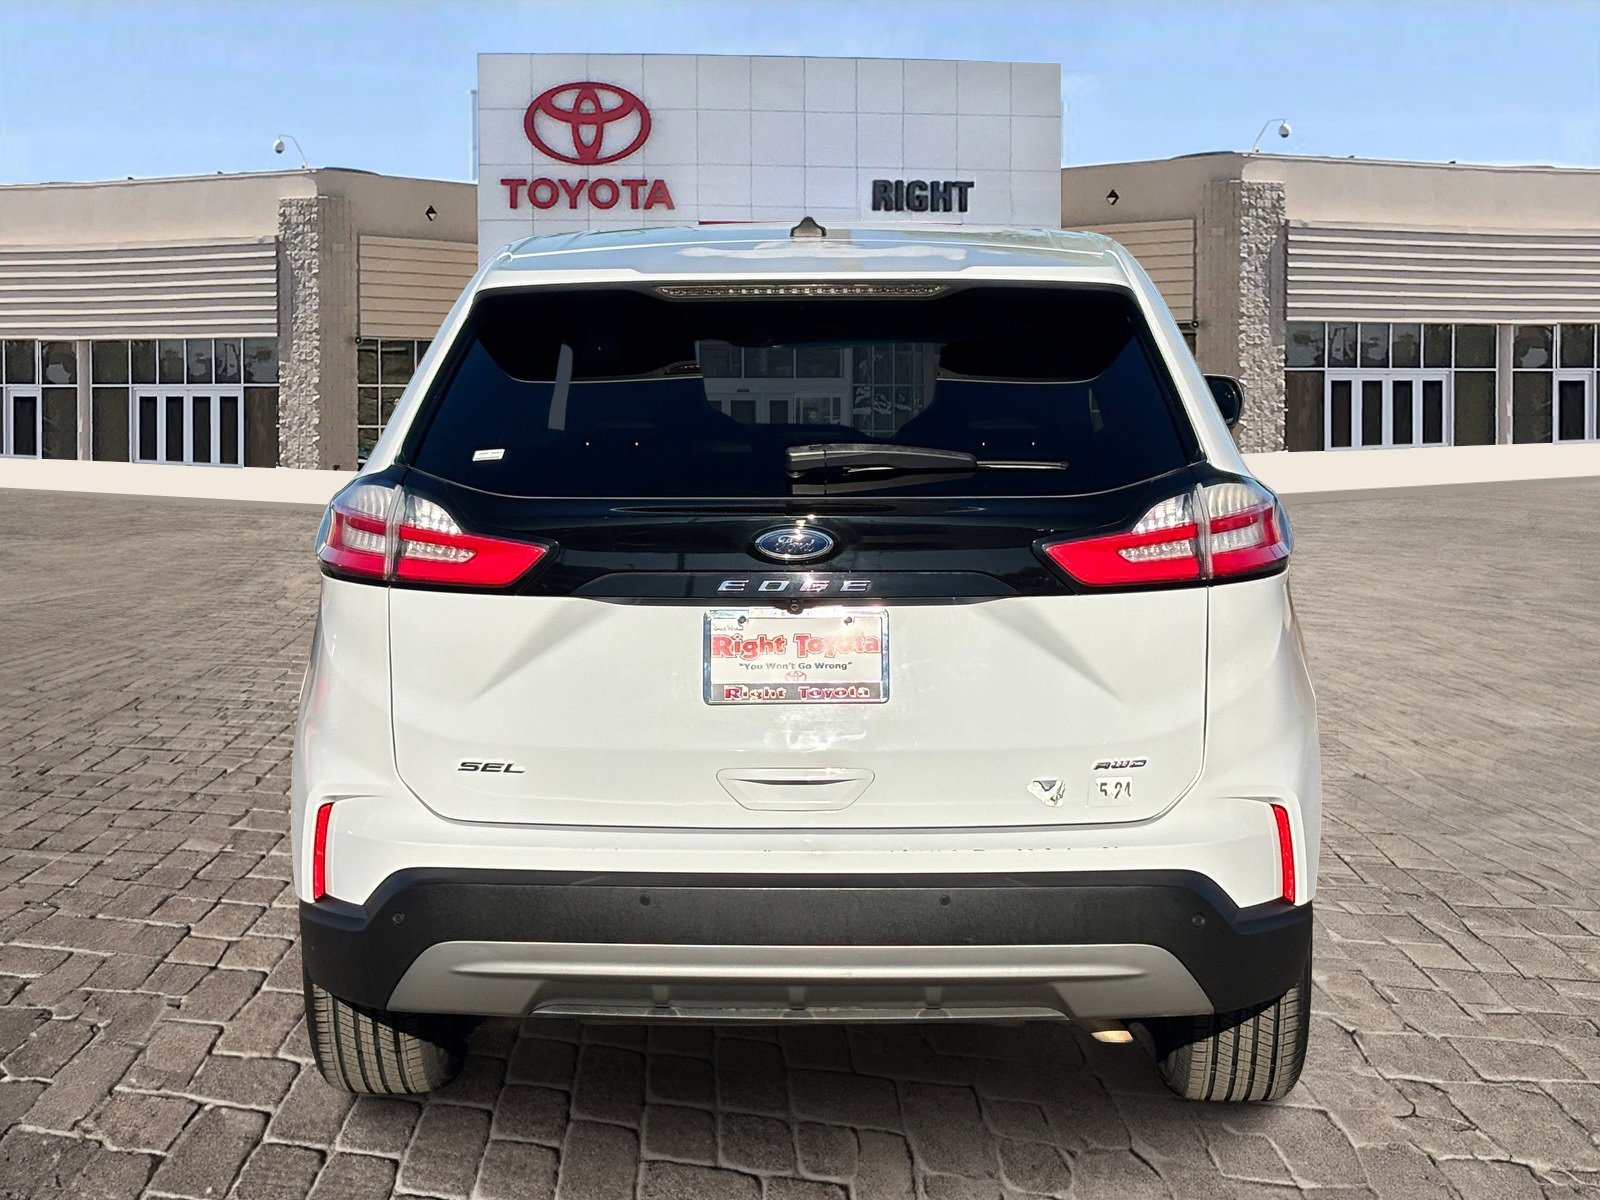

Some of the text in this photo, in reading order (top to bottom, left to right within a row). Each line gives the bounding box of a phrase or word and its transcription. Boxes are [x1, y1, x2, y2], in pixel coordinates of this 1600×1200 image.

[500, 178, 675, 210] TOYOTA
[871, 180, 975, 212] RIGHT
[717, 580, 871, 592] EDGE
[712, 634, 882, 660] Right Toyota
[765, 662, 796, 670] Won't
[798, 662, 812, 670] Go
[723, 685, 872, 701] Right Toyota
[457, 761, 526, 774] SEL
[1093, 759, 1148, 770] AWD
